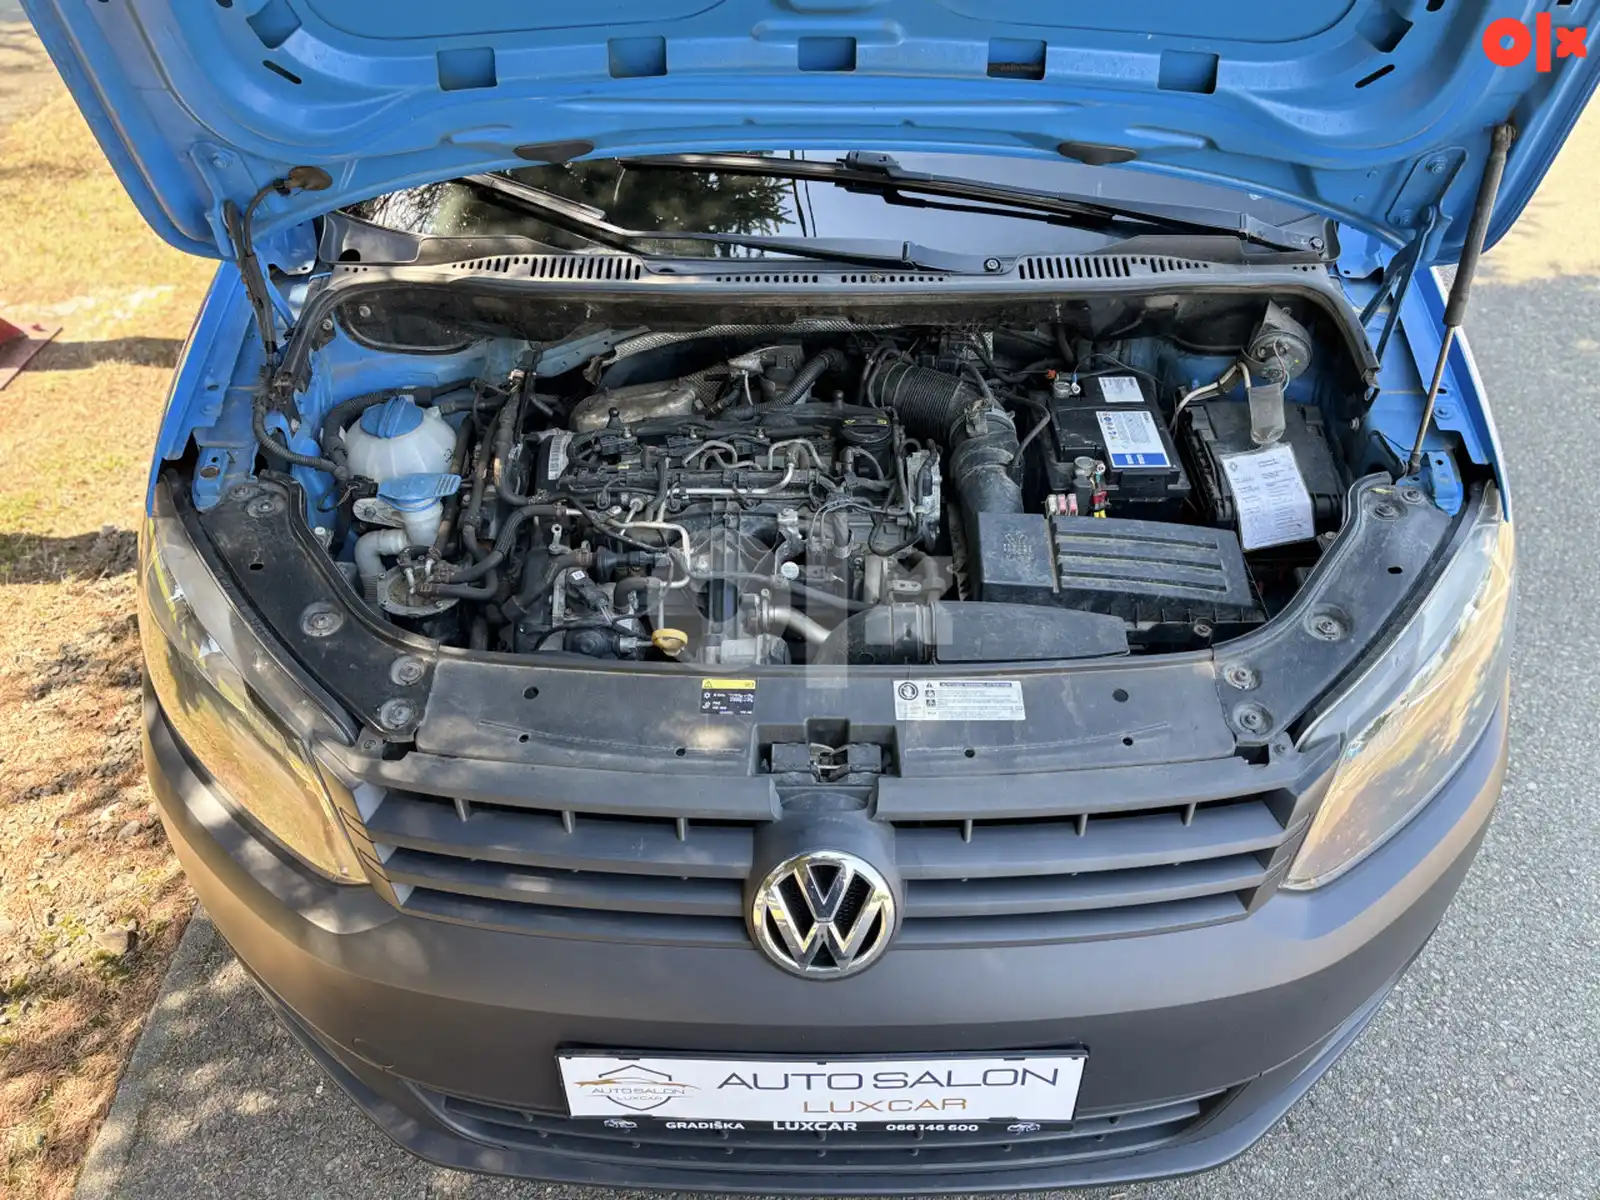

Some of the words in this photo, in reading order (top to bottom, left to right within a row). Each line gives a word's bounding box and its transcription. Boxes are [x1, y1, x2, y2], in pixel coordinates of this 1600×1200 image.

[717, 1072, 863, 1090] AUTO
[873, 1068, 1058, 1088] SALON
[804, 1098, 967, 1113] LUXCAR
[665, 1120, 745, 1130] GRADIŠKA
[773, 1121, 857, 1131] LUXCAR
[886, 1123, 918, 1131] 066
[919, 1123, 945, 1131] 146
[948, 1123, 979, 1131] 600
